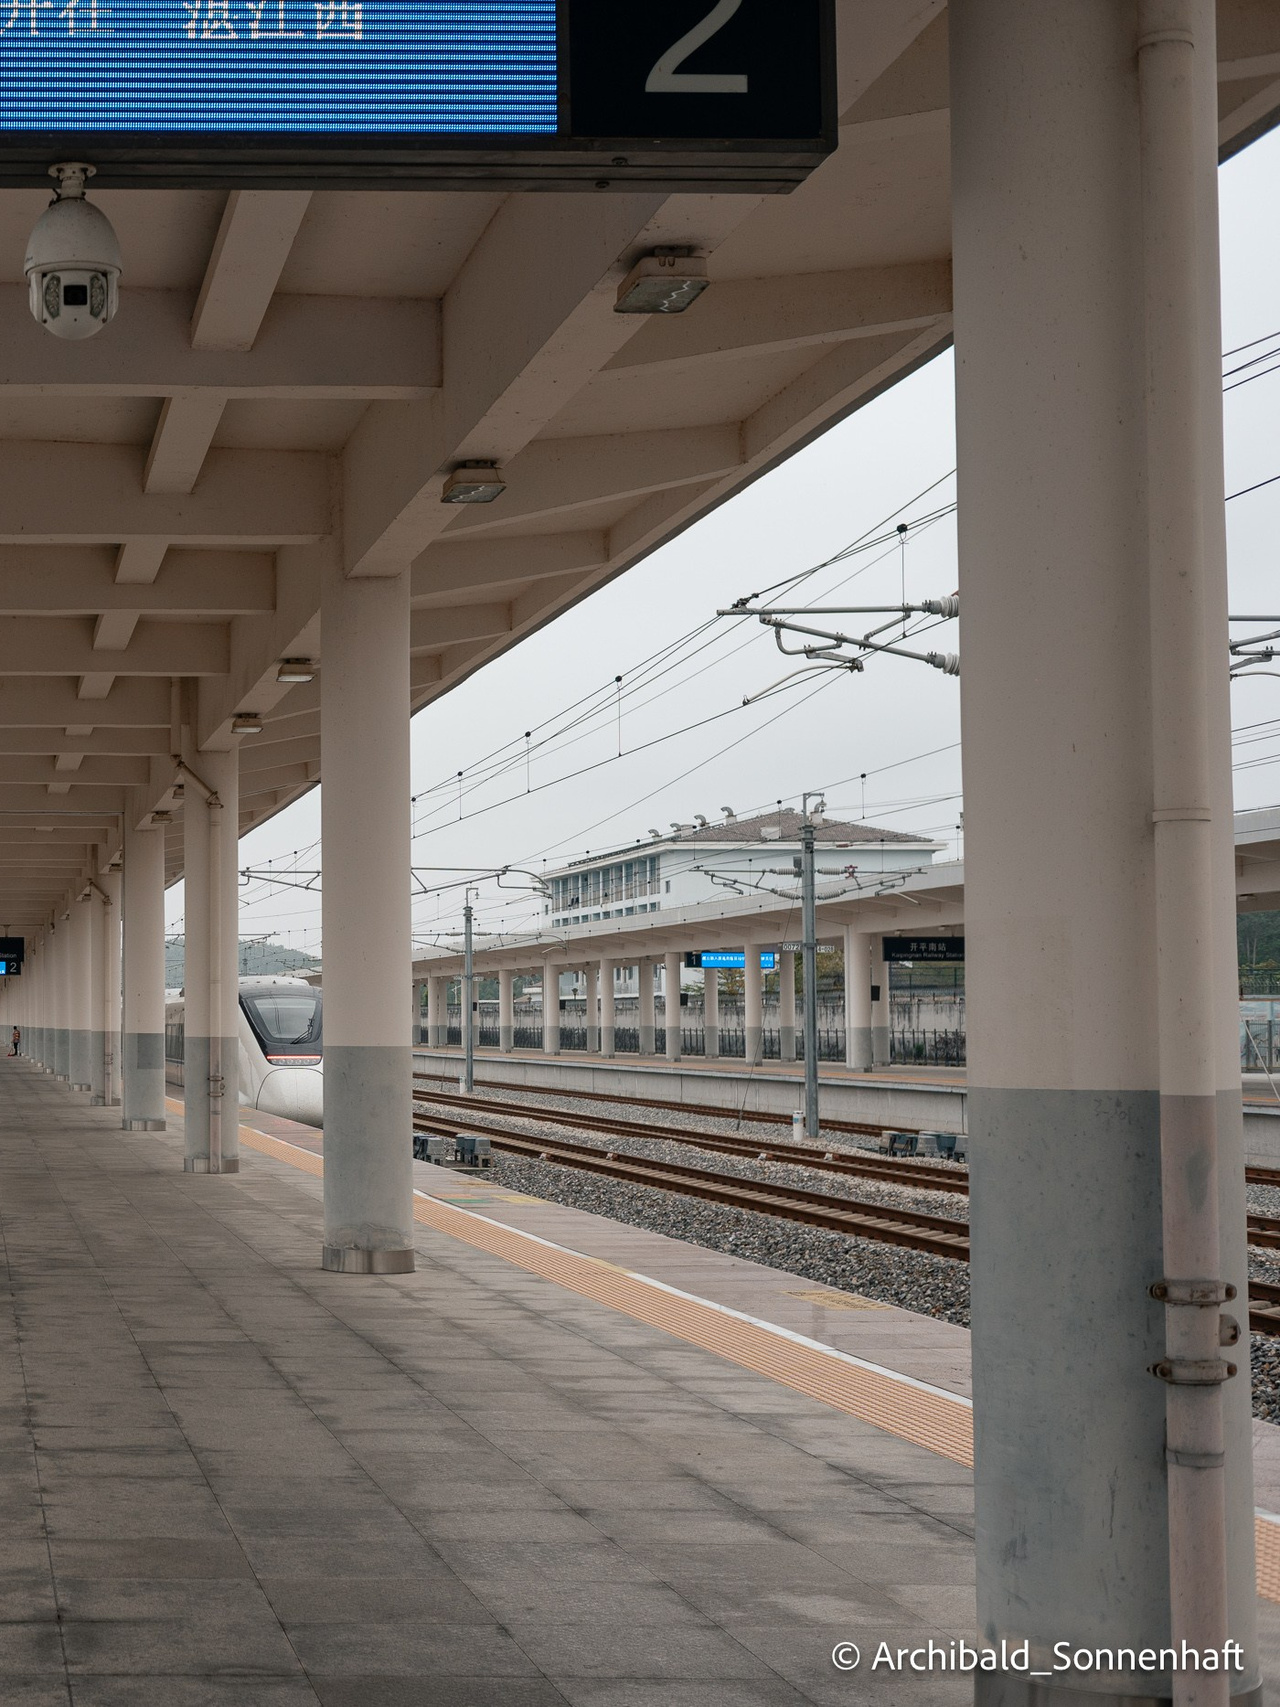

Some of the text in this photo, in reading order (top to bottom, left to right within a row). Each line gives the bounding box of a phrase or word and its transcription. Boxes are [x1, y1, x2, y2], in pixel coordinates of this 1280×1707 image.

[644, 0, 748, 93] 2
[909, 942, 947, 952] 开平南站
[9, 962, 17, 973] 2
